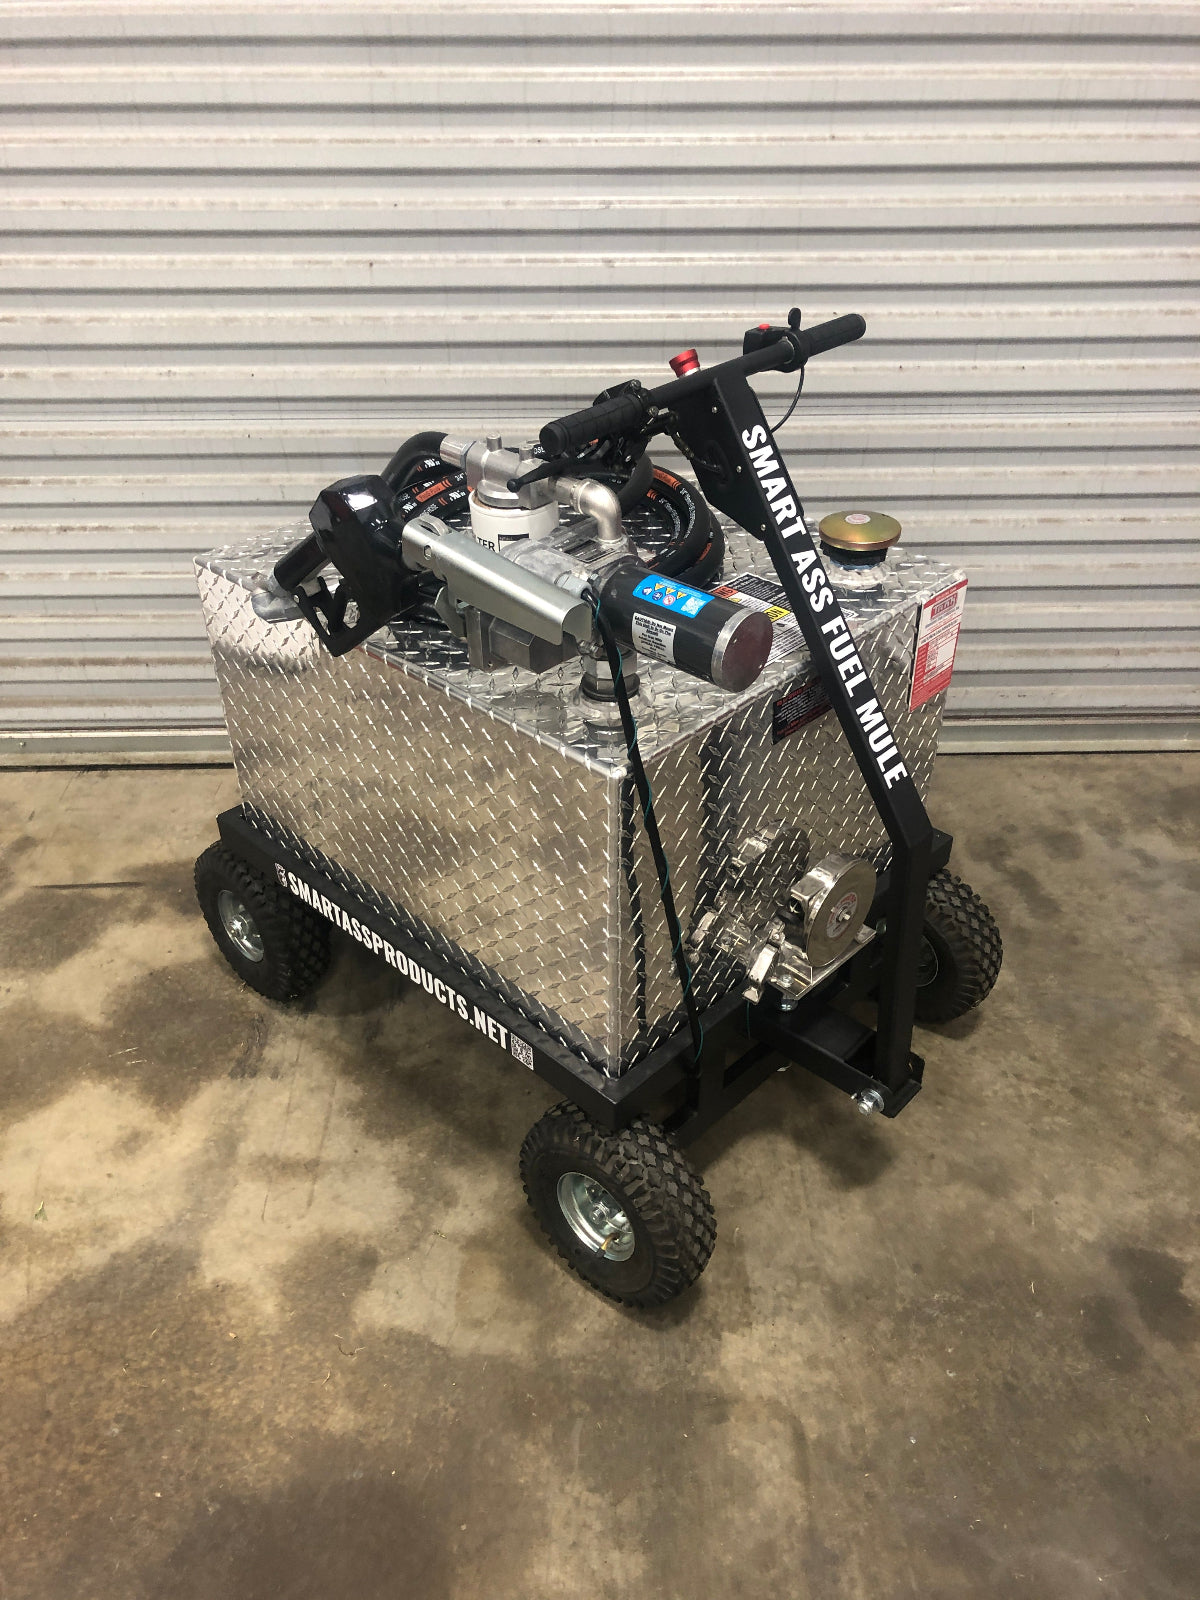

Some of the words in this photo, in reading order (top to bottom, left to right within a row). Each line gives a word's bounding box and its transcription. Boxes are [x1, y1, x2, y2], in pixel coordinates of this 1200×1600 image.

[477, 536, 496, 552] TER
[742, 424, 807, 539] SMART
[790, 549, 834, 613] ASS
[821, 615, 868, 698] FUEL
[855, 697, 908, 789] MULE
[287, 872, 508, 1049] SMARTASSPRODUCTS.NET
